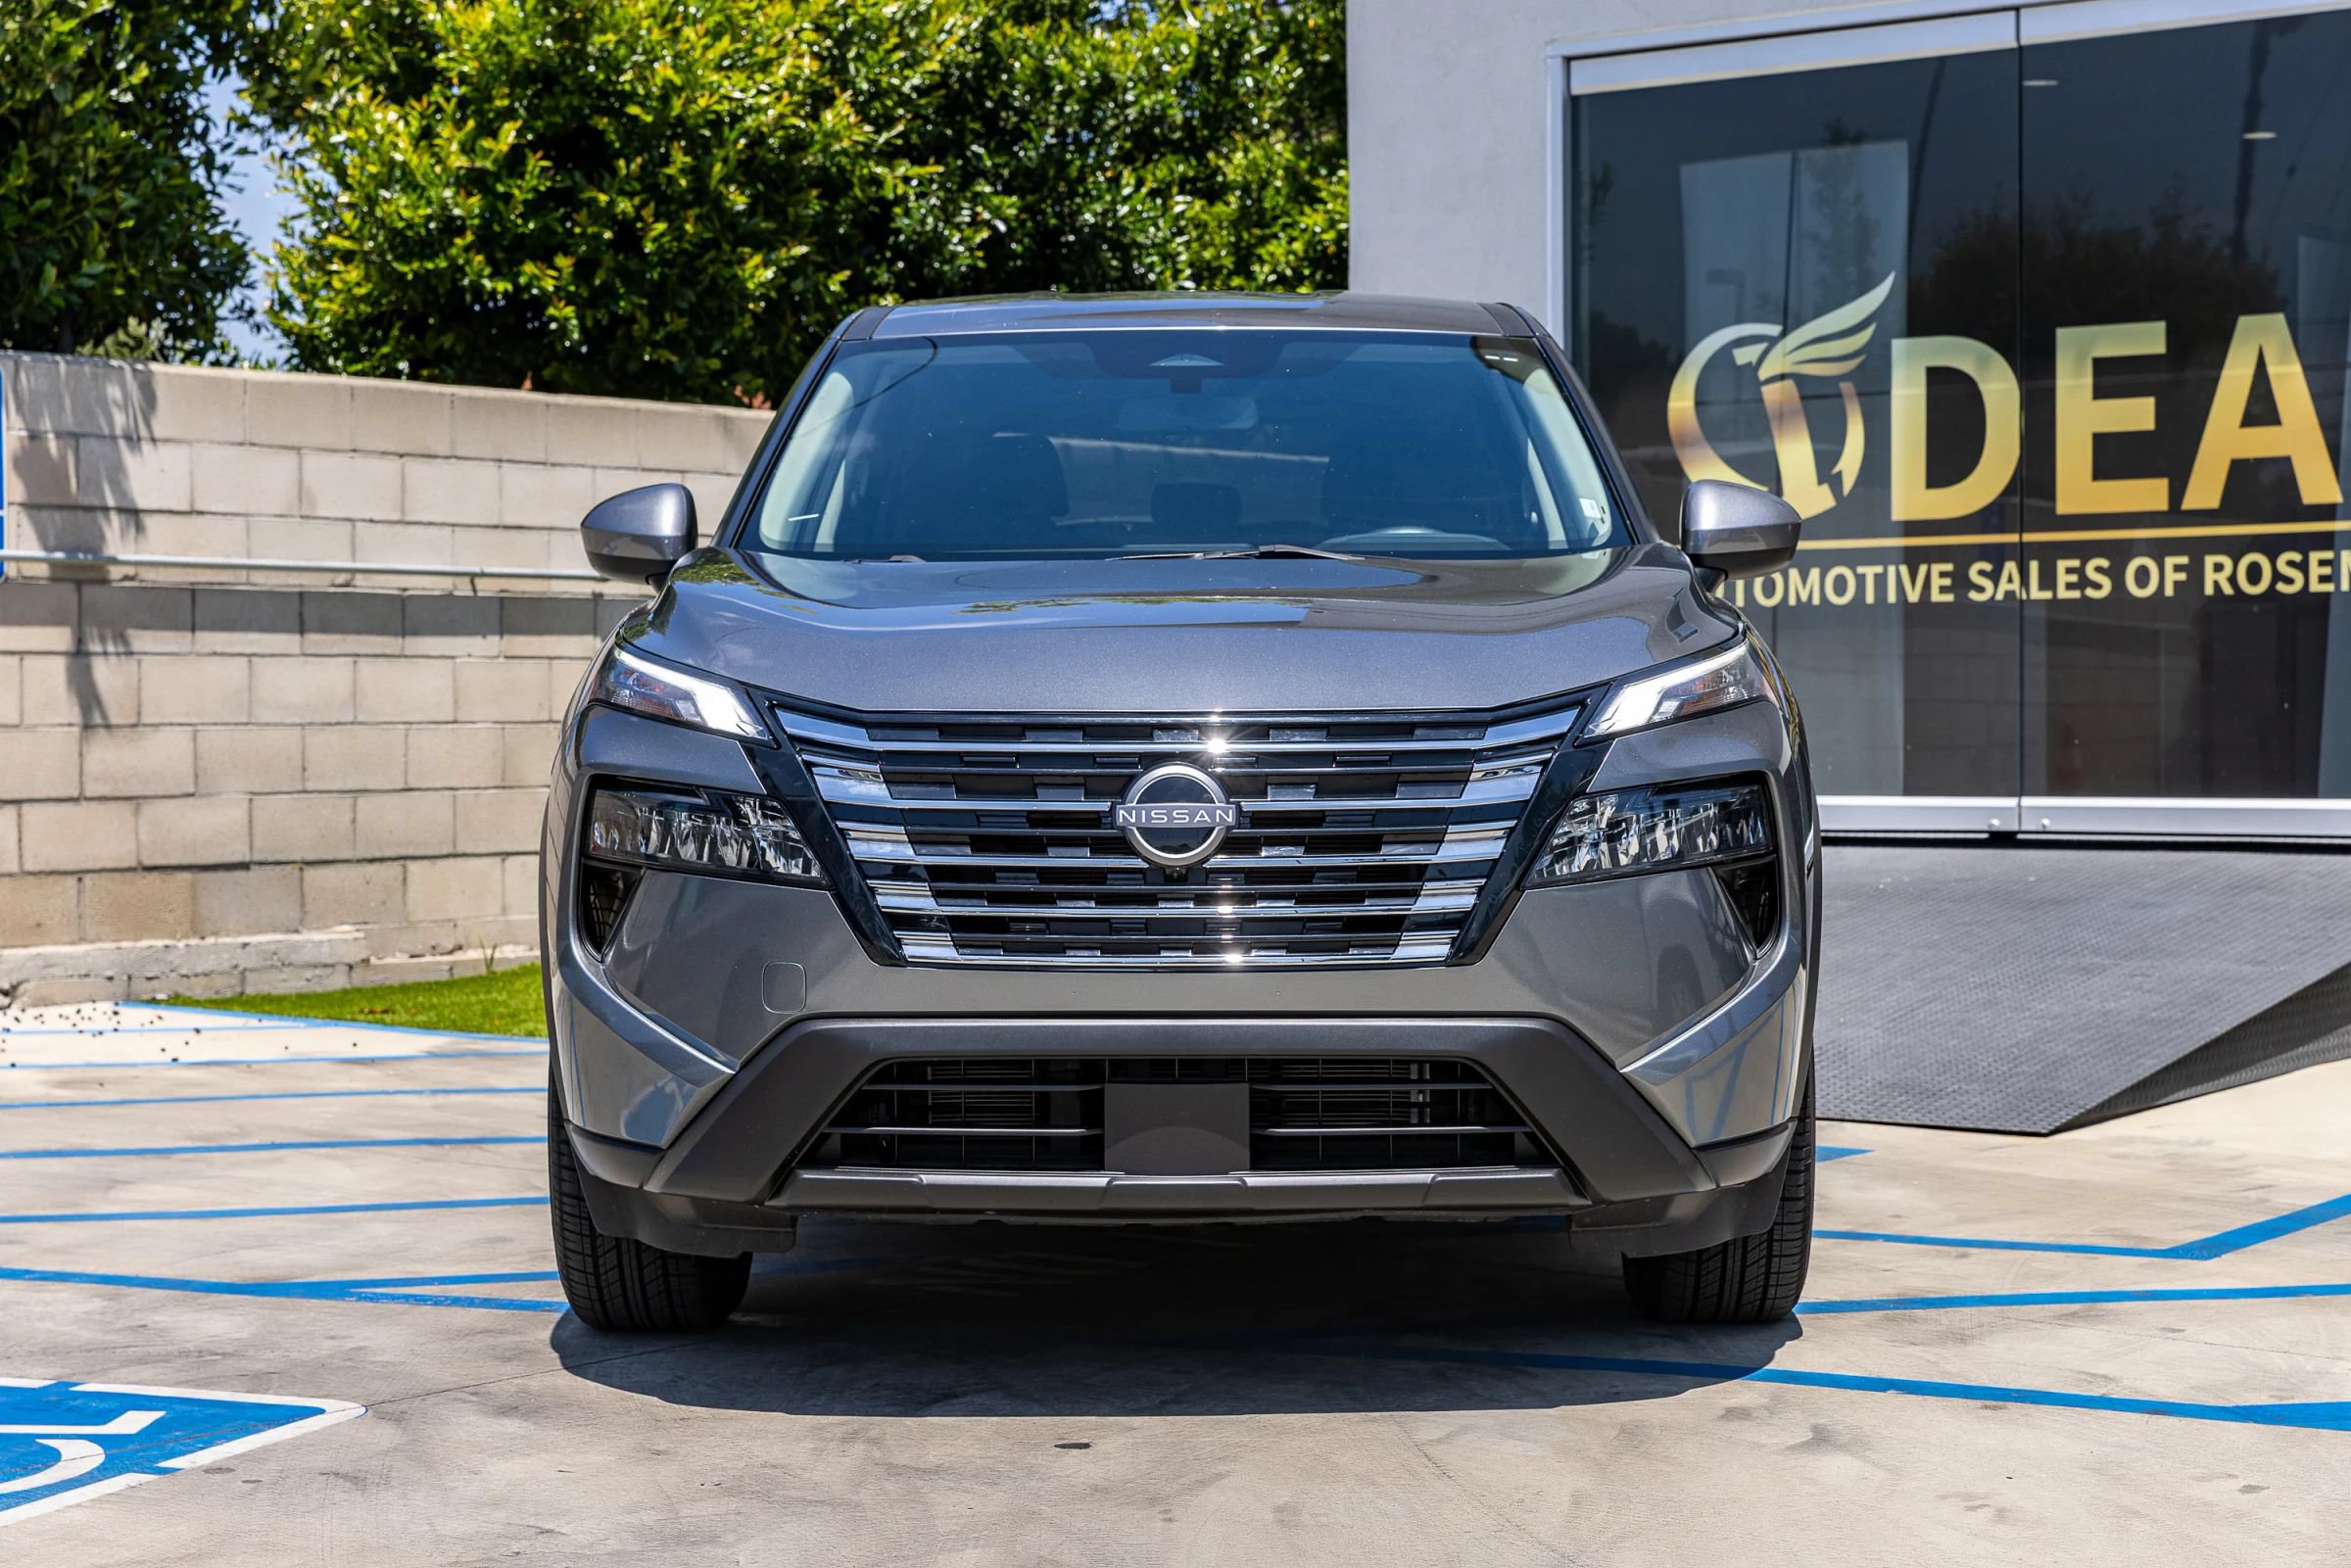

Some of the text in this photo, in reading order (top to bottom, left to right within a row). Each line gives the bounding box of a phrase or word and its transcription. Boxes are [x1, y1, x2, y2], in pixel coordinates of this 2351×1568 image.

[1715, 549, 2351, 608] TOMOTIVE SALES OF ROSE
[1119, 809, 1233, 824] NISSAN
